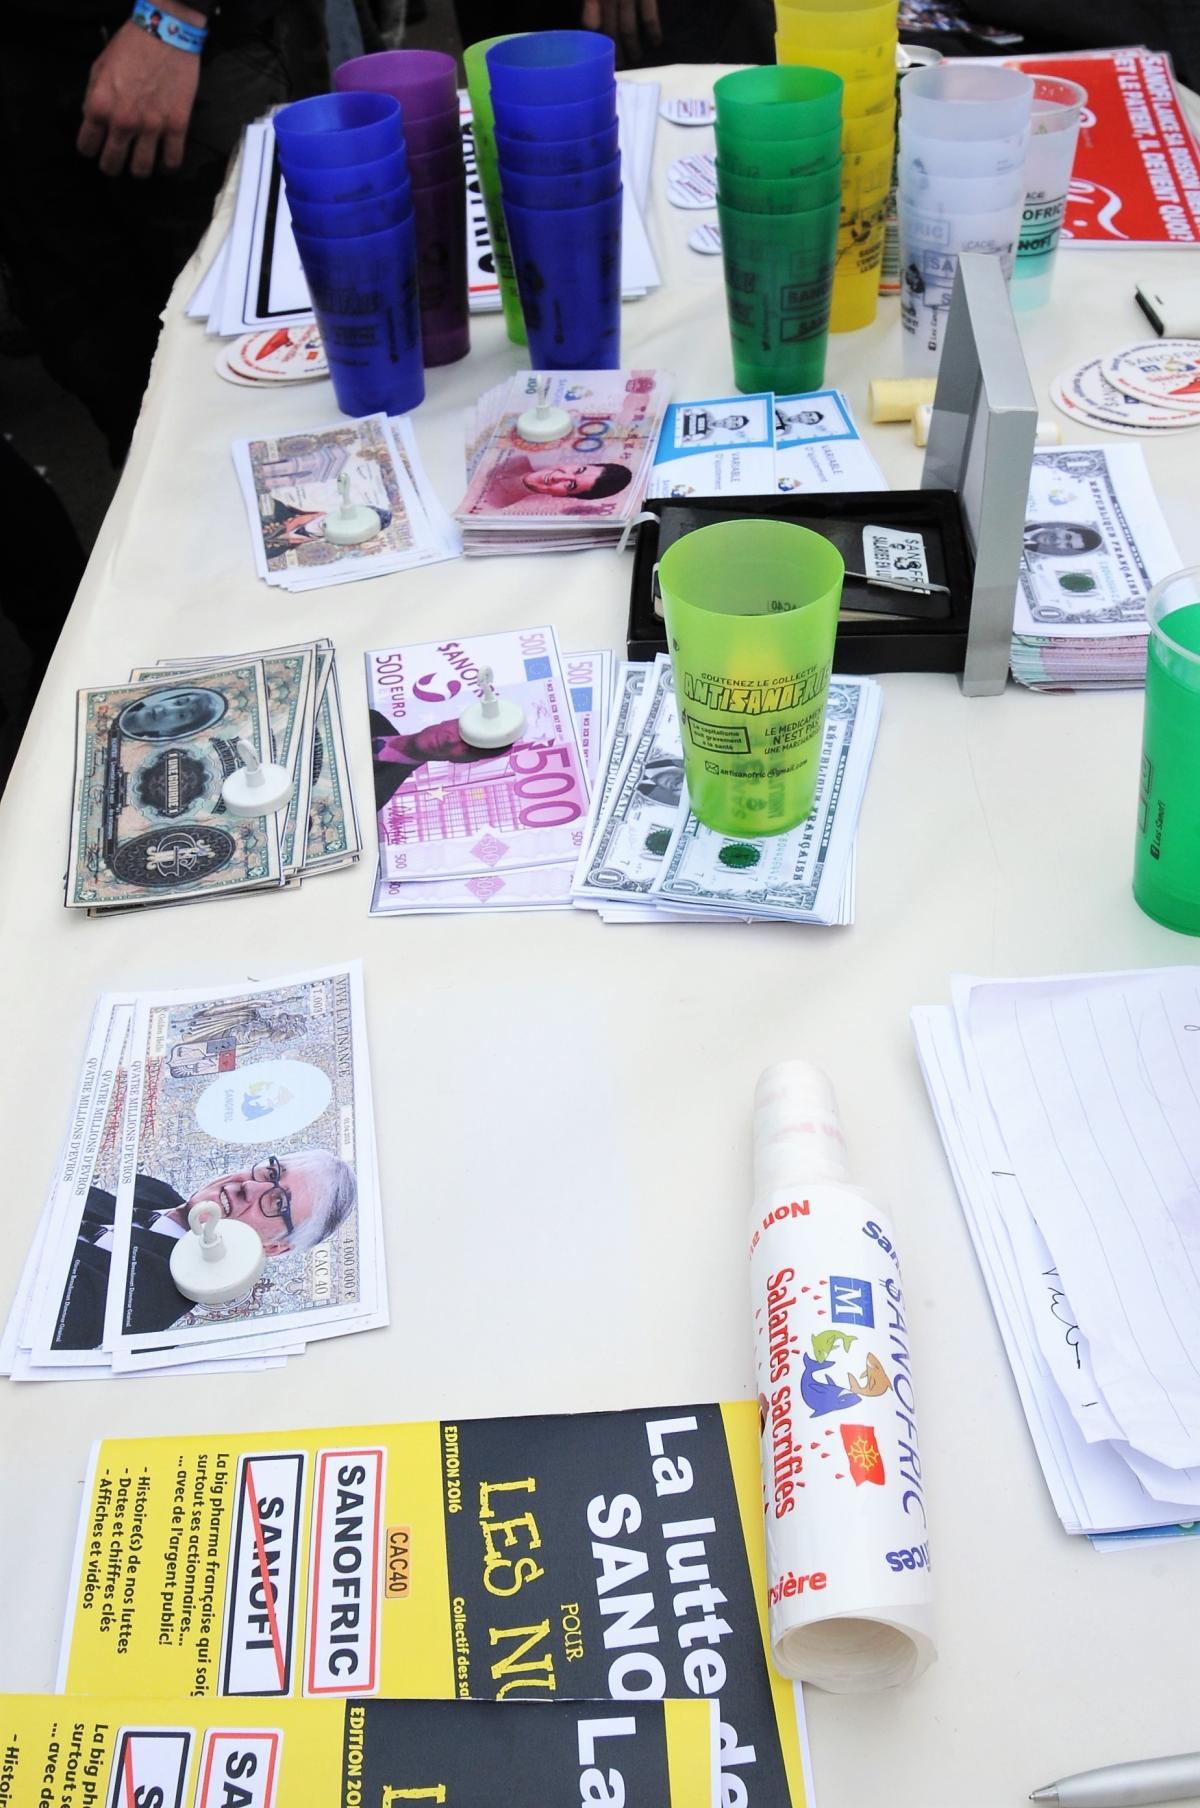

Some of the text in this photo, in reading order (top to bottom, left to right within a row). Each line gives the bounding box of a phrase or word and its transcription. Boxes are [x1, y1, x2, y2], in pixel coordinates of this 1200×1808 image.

[376, 653, 407, 718] 500 EURO
[508, 747, 582, 828] 500
[129, 1060, 141, 1097] QVATRE
[337, 1026, 351, 1078] FINANCE
[62, 1057, 98, 1182] QVATRE MILLIONS D'EVROS
[75, 1070, 113, 1196] QVATRE MILLIONS D'EVROS
[126, 1098, 139, 1143] MILLIONS
[121, 1144, 135, 1184] D'EVROS
[762, 1200, 811, 1230] Non
[314, 1249, 330, 1295] CAC 40
[343, 1245, 355, 1267] 000
[343, 1268, 355, 1289] 000
[766, 1267, 806, 1520] Salariés sacrifiés
[173, 1469, 191, 1503] avec
[206, 1471, 229, 1495] big
[214, 1452, 230, 1470] La
[443, 1425, 462, 1514] EDITION 2016
[645, 1415, 699, 1498] La
[82, 1477, 115, 1610] Affiches et vidéos
[170, 1505, 188, 1526] de
[204, 1496, 226, 1558] pharma
[479, 1477, 546, 1597] LES
[98, 1477, 133, 1633] Dates et chiffres clés
[116, 1475, 152, 1655] Histoire(s) de nos luttes
[162, 1526, 187, 1589] l'argent
[177, 1453, 211, 1647] surtout ses actionnaires...
[246, 1496, 285, 1651] SANOFI
[328, 1464, 367, 1677] SANOFRIC
[388, 1531, 410, 1593] CAC40
[157, 1590, 179, 1647] public!
[197, 1559, 220, 1634] française
[453, 1596, 470, 1655] Collectif
[586, 1493, 667, 1701] SANO
[661, 1516, 734, 1696] lutte
[193, 1636, 214, 1665] qui
[560, 1602, 584, 1663] POUR
[456, 1656, 471, 1680] des
[42, 1742, 64, 1783] avec
[64, 1722, 86, 1790] surtout
[83, 1746, 107, 1777] big
[91, 1723, 109, 1743] La
[346, 1706, 366, 1777] EDITION
[577, 1716, 637, 1808] La
[220, 1751, 258, 1808] SA
